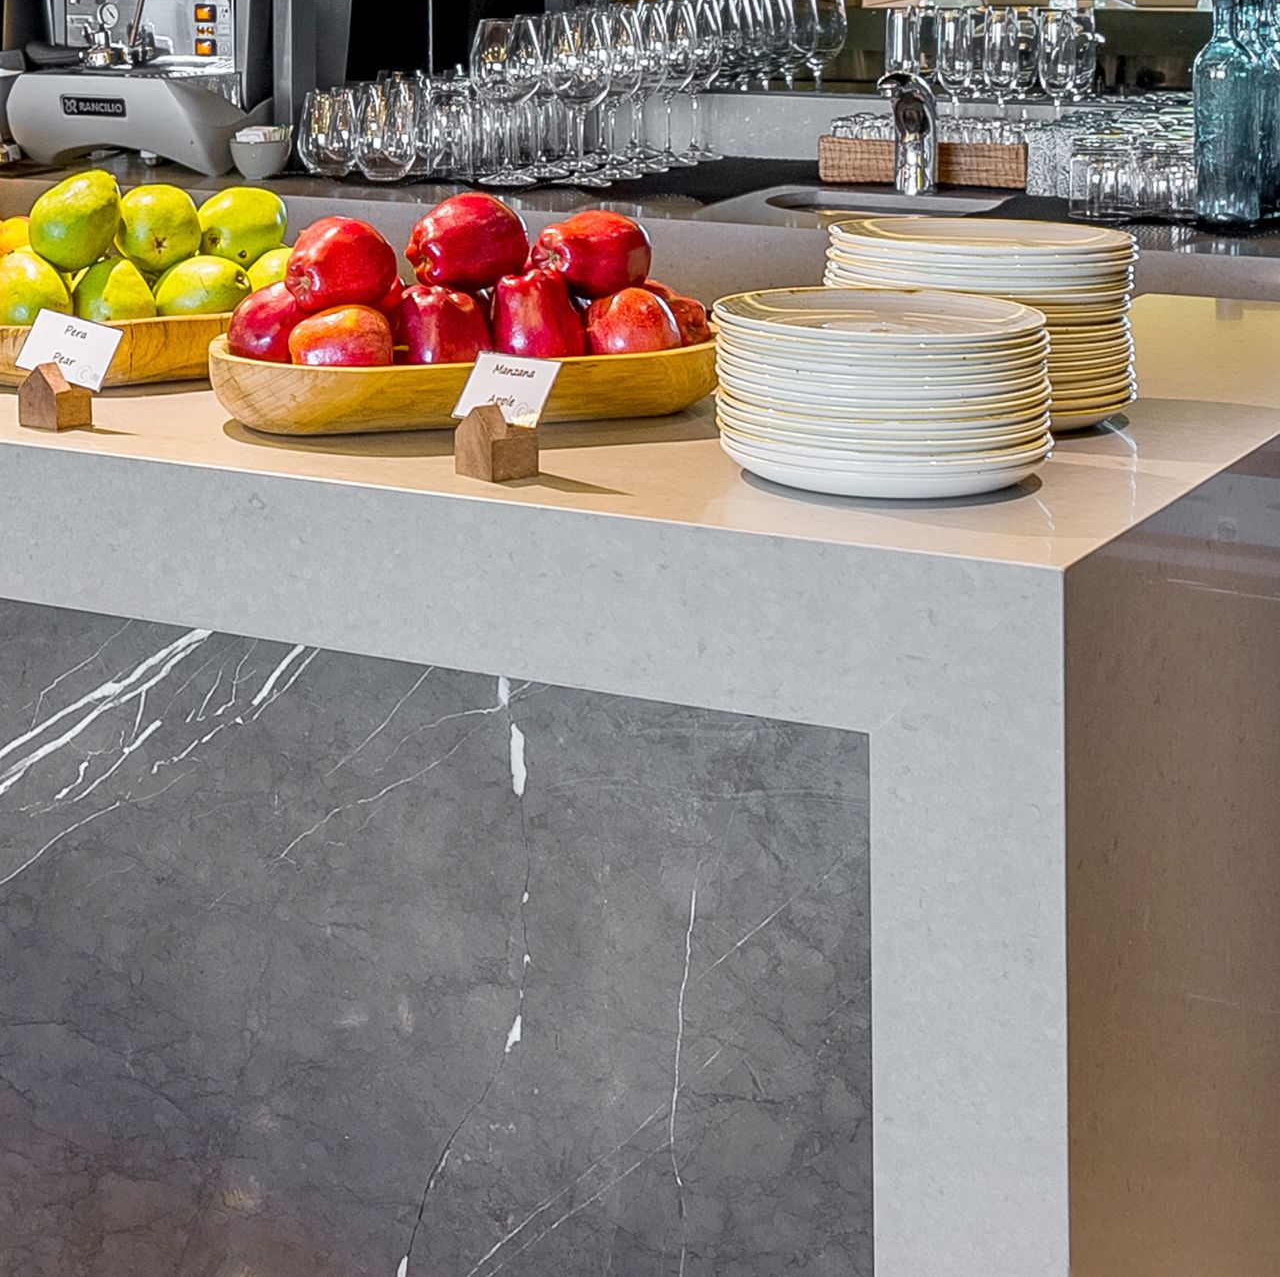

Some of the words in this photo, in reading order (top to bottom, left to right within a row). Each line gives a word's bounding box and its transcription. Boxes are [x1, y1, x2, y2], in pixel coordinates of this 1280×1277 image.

[79, 102, 122, 113] RANCILIO
[64, 324, 88, 339] Pera
[52, 352, 76, 366] Pear
[492, 364, 536, 378] Manzana
[487, 394, 516, 407] Apple
